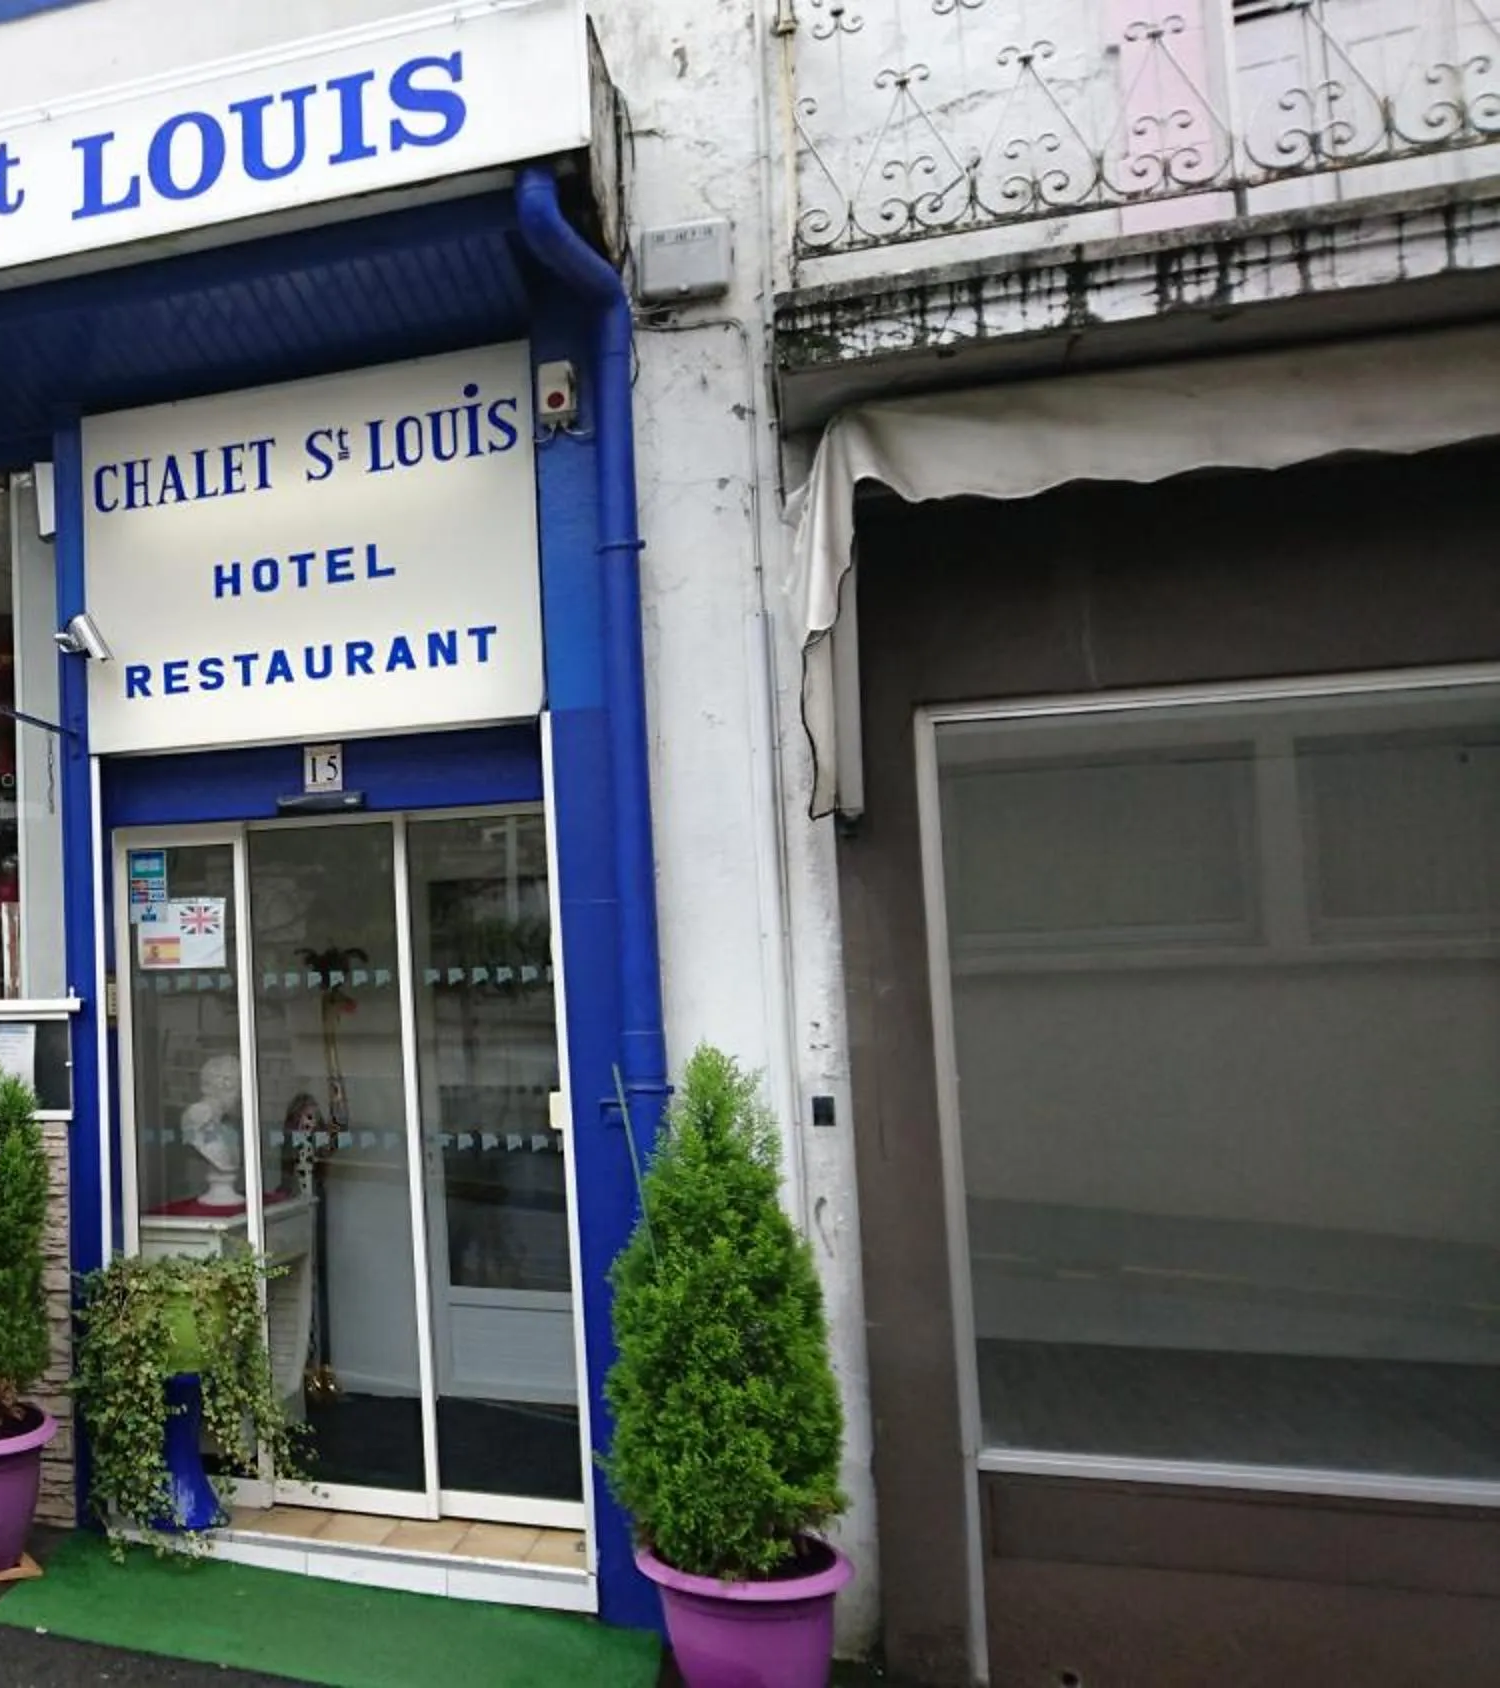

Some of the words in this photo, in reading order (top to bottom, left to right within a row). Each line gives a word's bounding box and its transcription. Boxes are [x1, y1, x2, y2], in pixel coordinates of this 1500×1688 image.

[71, 50, 468, 221] LOUIS
[93, 438, 276, 513] CHALET
[213, 543, 396, 598] HOTEL
[125, 625, 497, 699] RESTAURANT
[311, 755, 339, 783] 15
